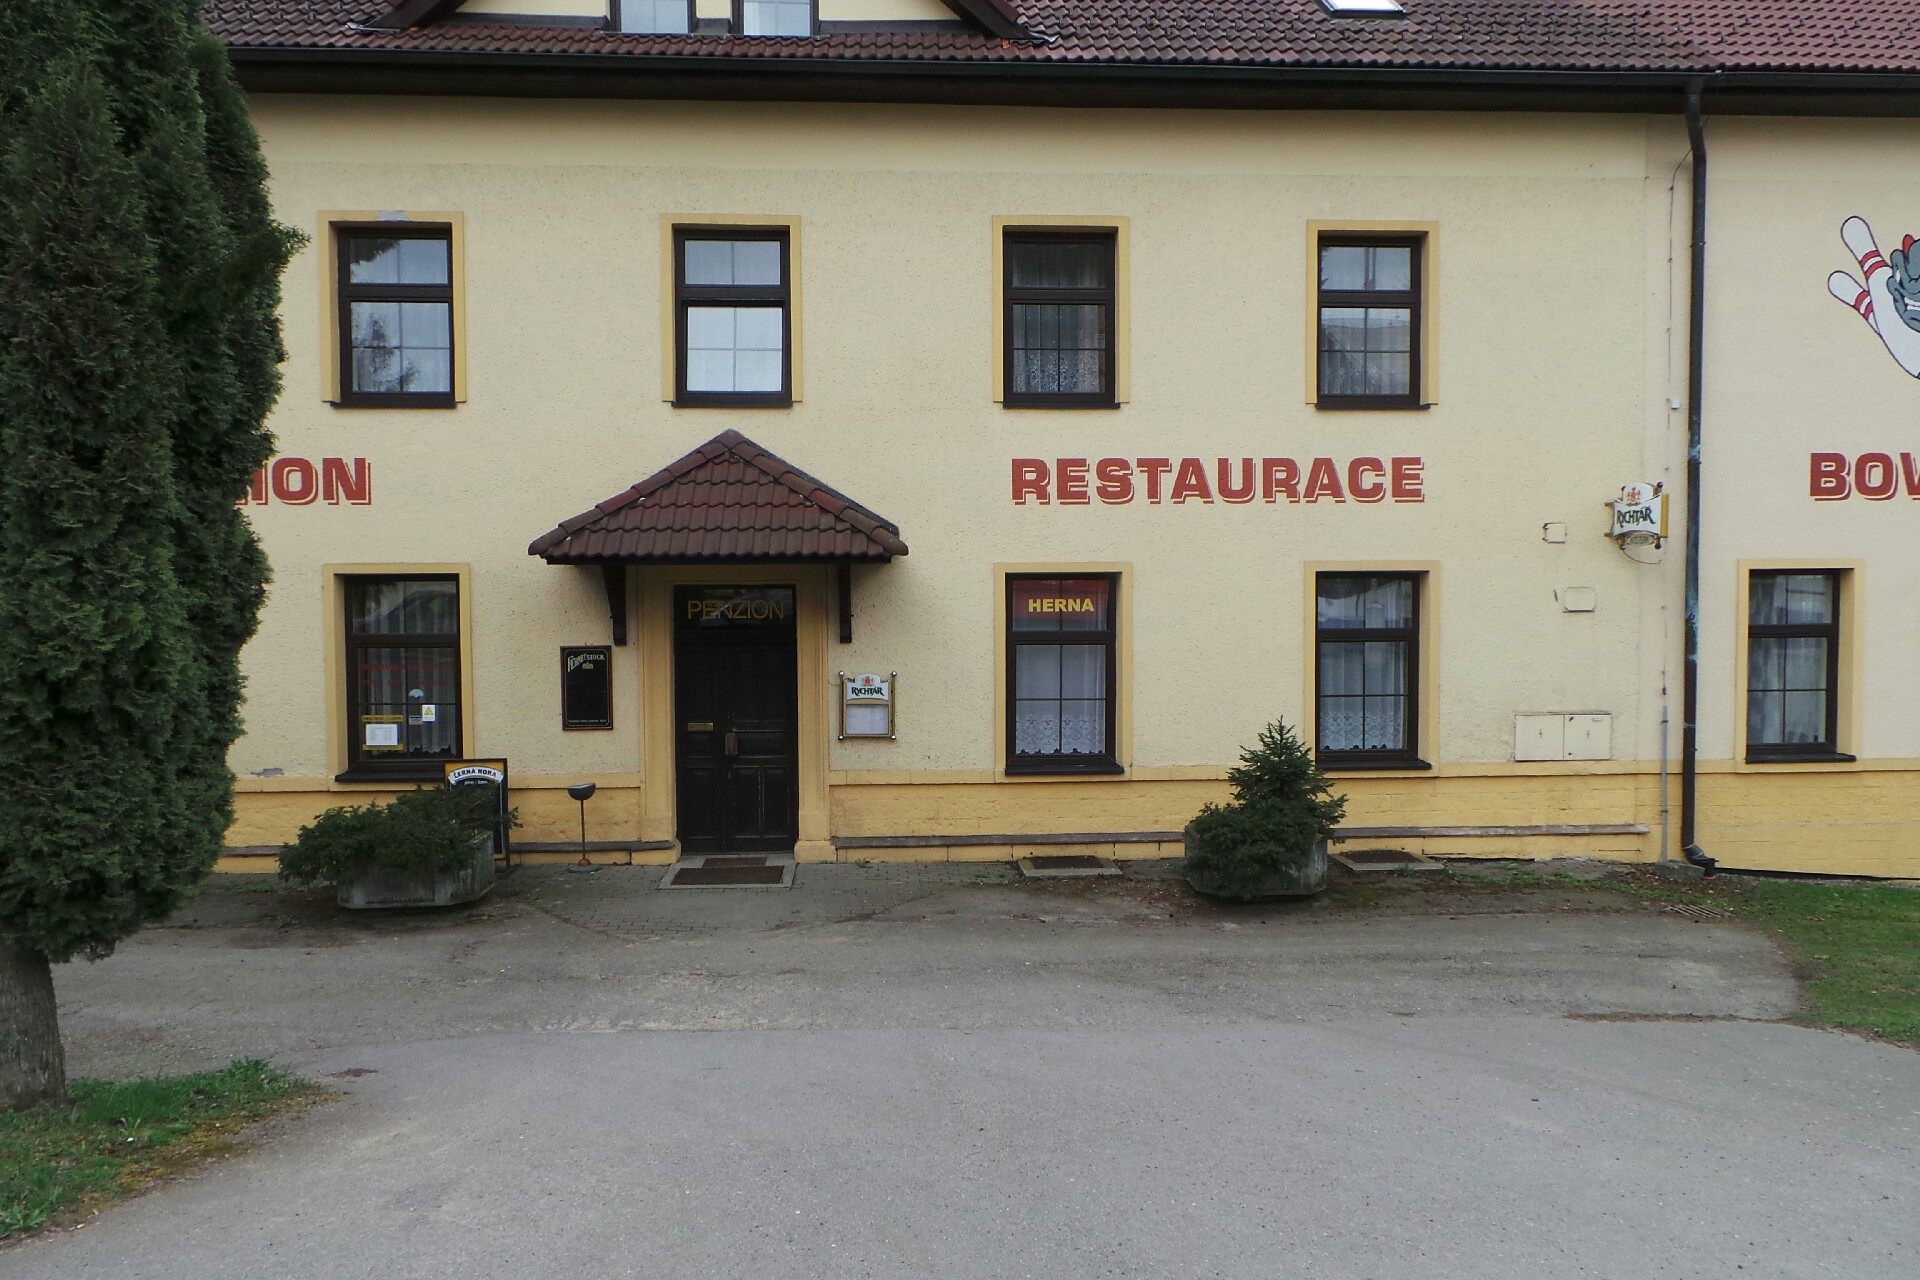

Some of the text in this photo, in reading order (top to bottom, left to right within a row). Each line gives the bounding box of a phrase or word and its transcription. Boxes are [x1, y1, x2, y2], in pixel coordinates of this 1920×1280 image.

[234, 457, 372, 506] ION
[1011, 456, 1425, 505] RESTAURACE
[687, 600, 784, 619] PENZION
[1028, 597, 1095, 613] HERNA
[453, 767, 497, 779] ČERNÁ HORA
